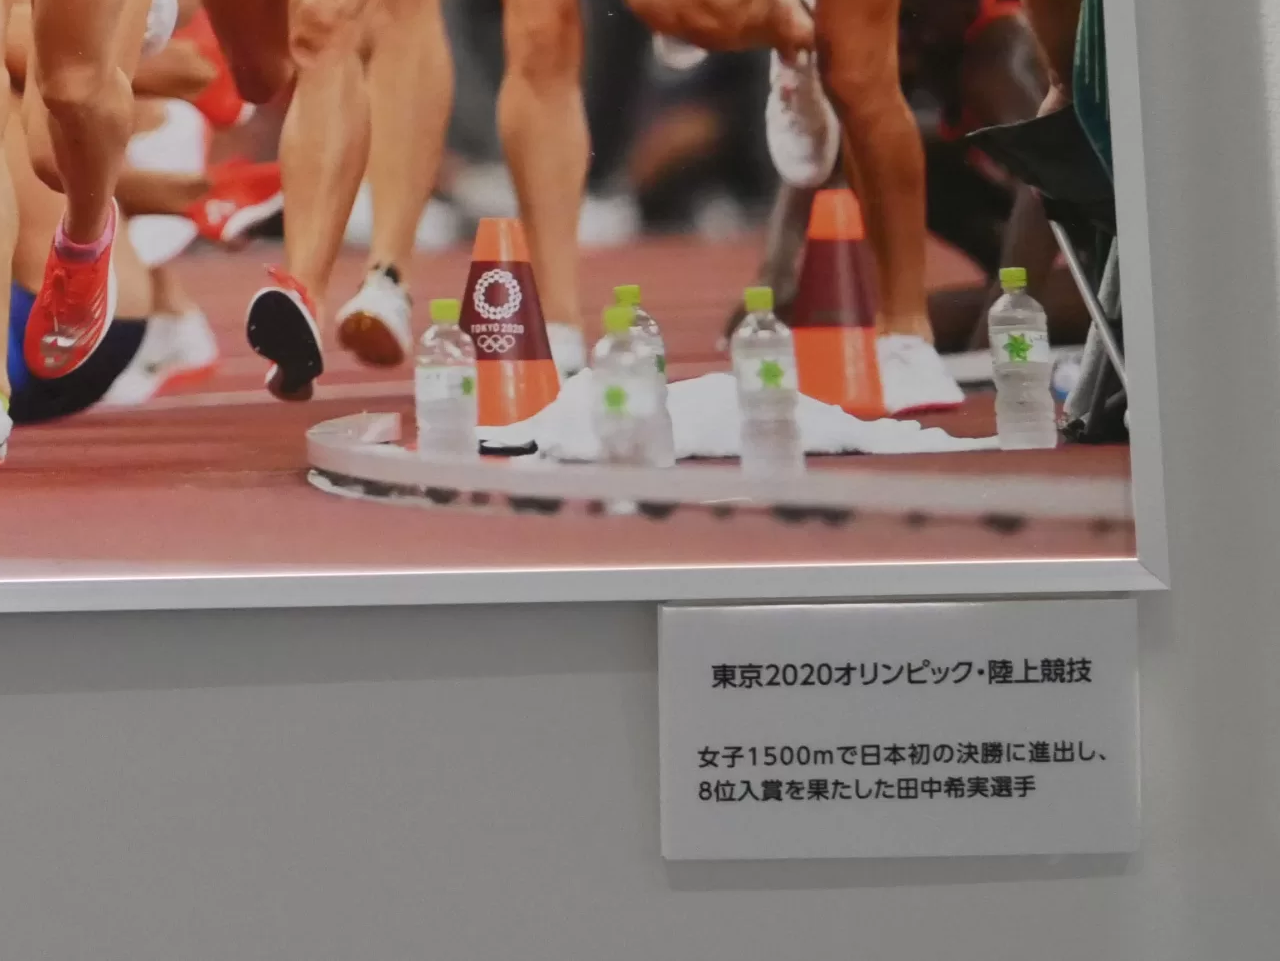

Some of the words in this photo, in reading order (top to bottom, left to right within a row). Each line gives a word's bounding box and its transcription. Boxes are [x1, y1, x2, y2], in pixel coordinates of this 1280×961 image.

[470, 323, 500, 334] TOKYO
[501, 323, 525, 334] 2020
[711, 657, 1093, 689] 東京2020オリンピック・陸上競技
[697, 740, 1108, 769] 女子1500mで日本初の決勝に進出し、
[698, 775, 1037, 803] 8位入賞を果たした田中希実選手
